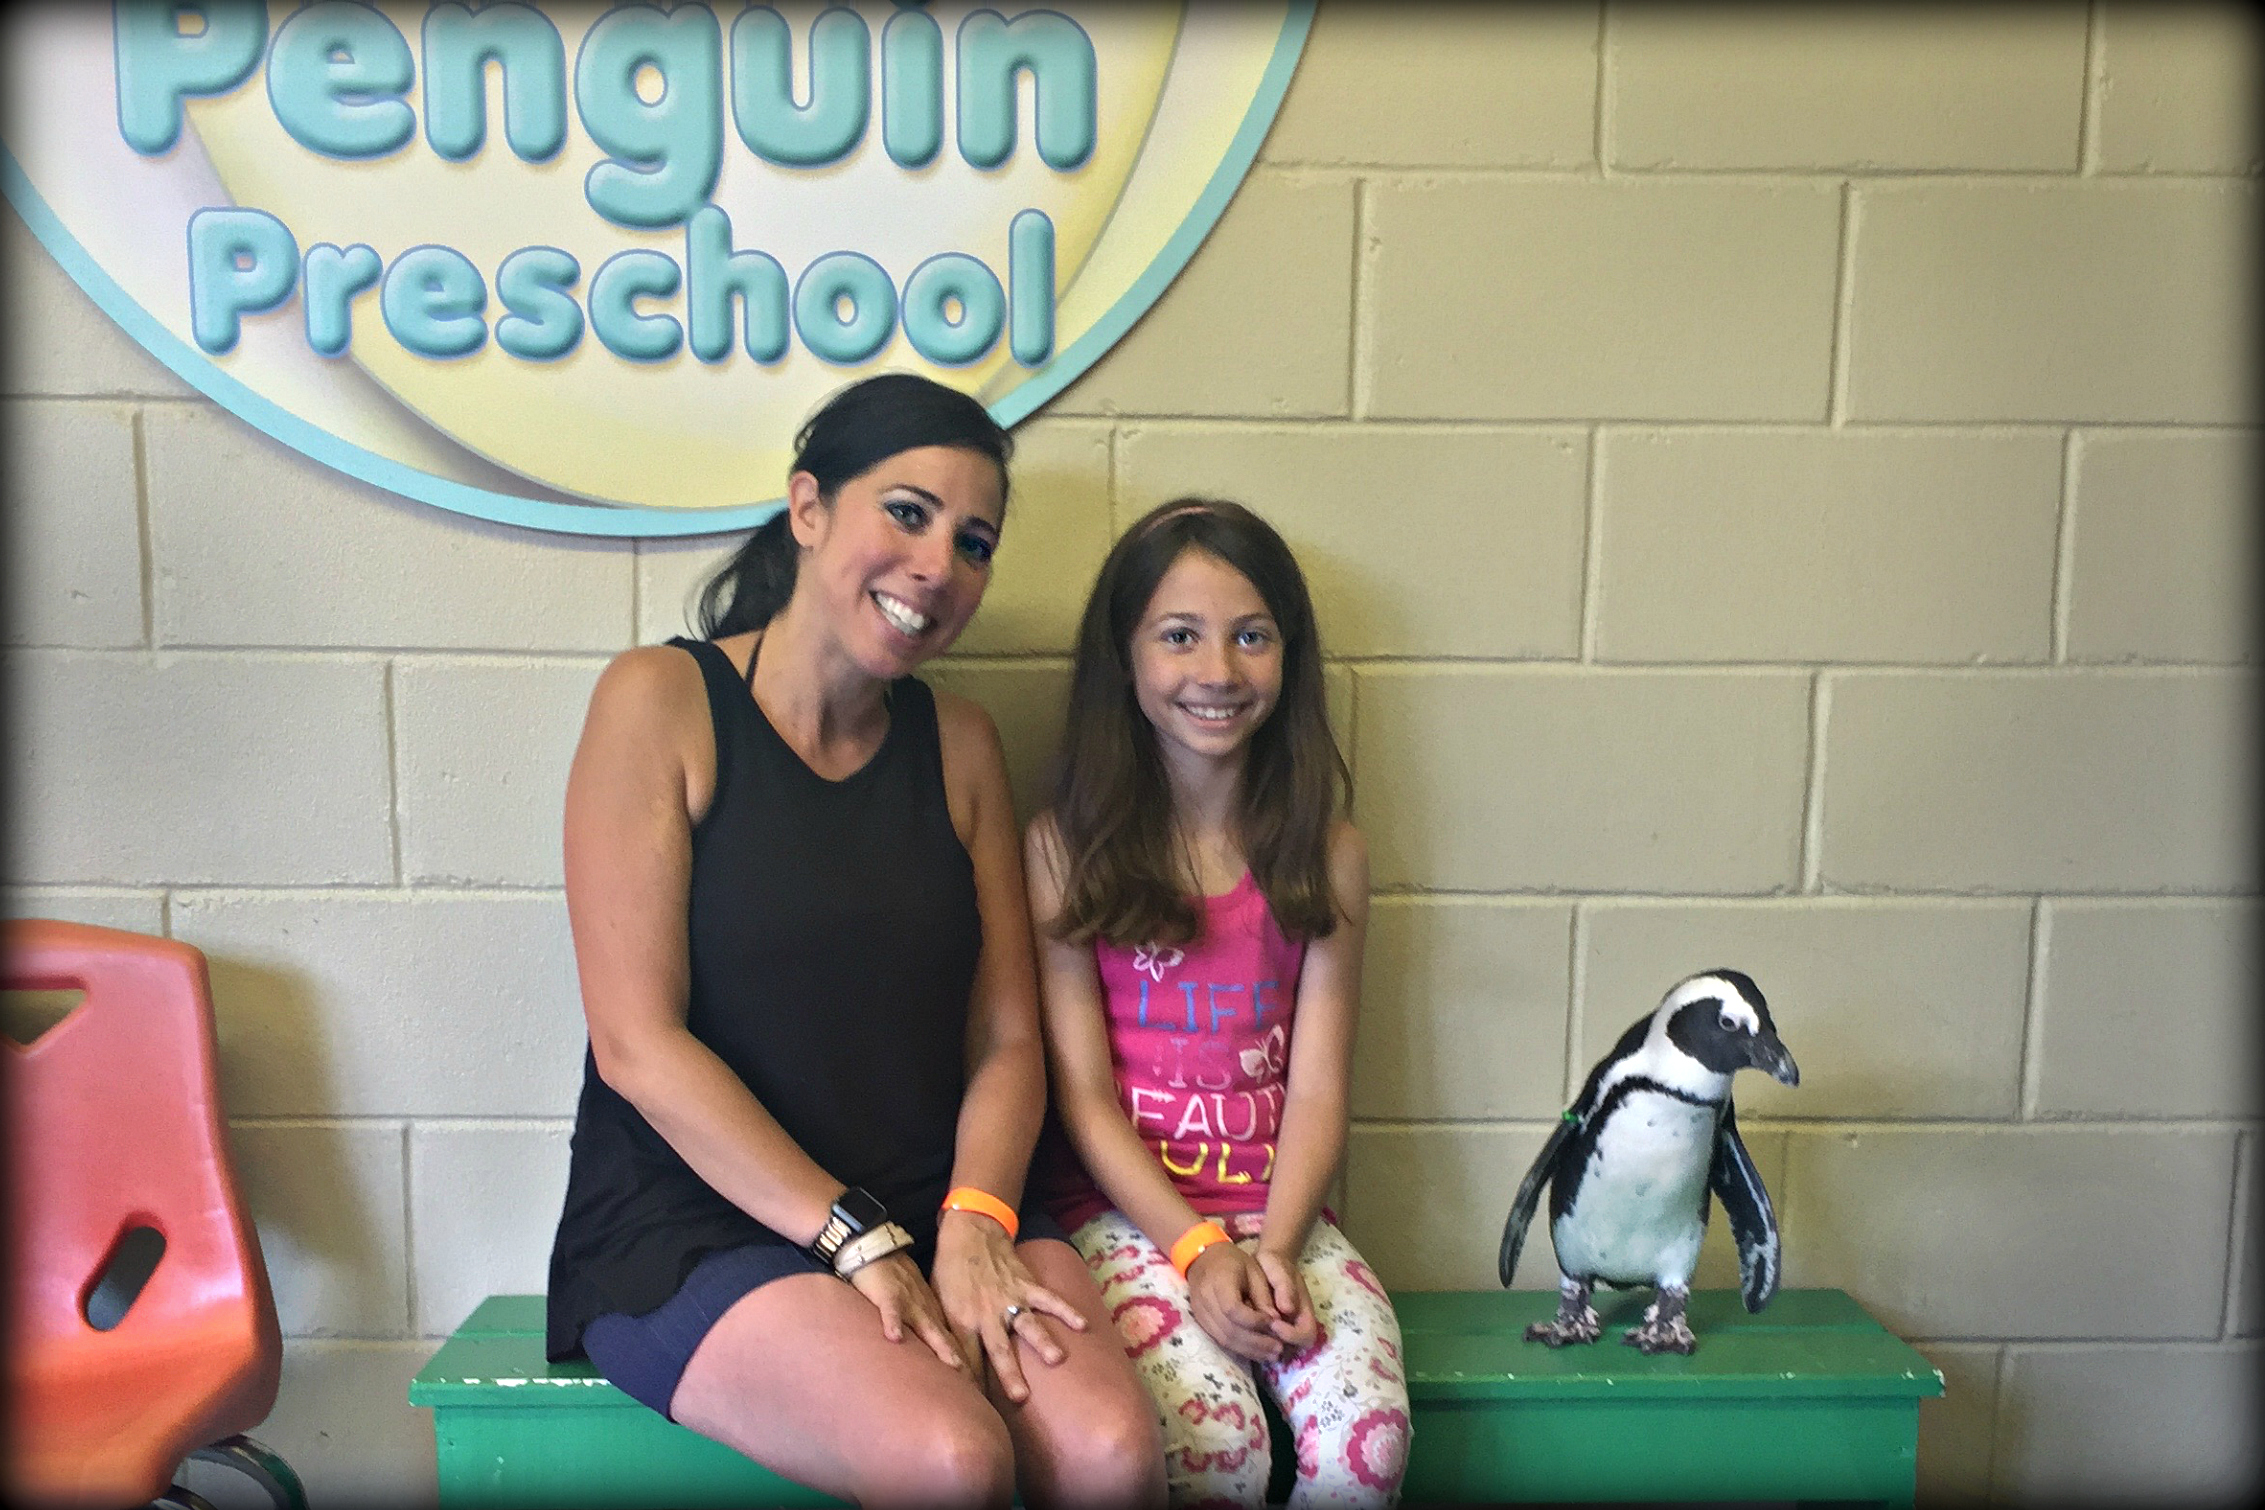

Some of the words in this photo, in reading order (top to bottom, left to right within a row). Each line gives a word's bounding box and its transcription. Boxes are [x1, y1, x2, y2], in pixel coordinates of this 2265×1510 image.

[112, 0, 1098, 231] Penguin
[187, 202, 1056, 369] Preschool
[1167, 1037, 1233, 1091] IS
